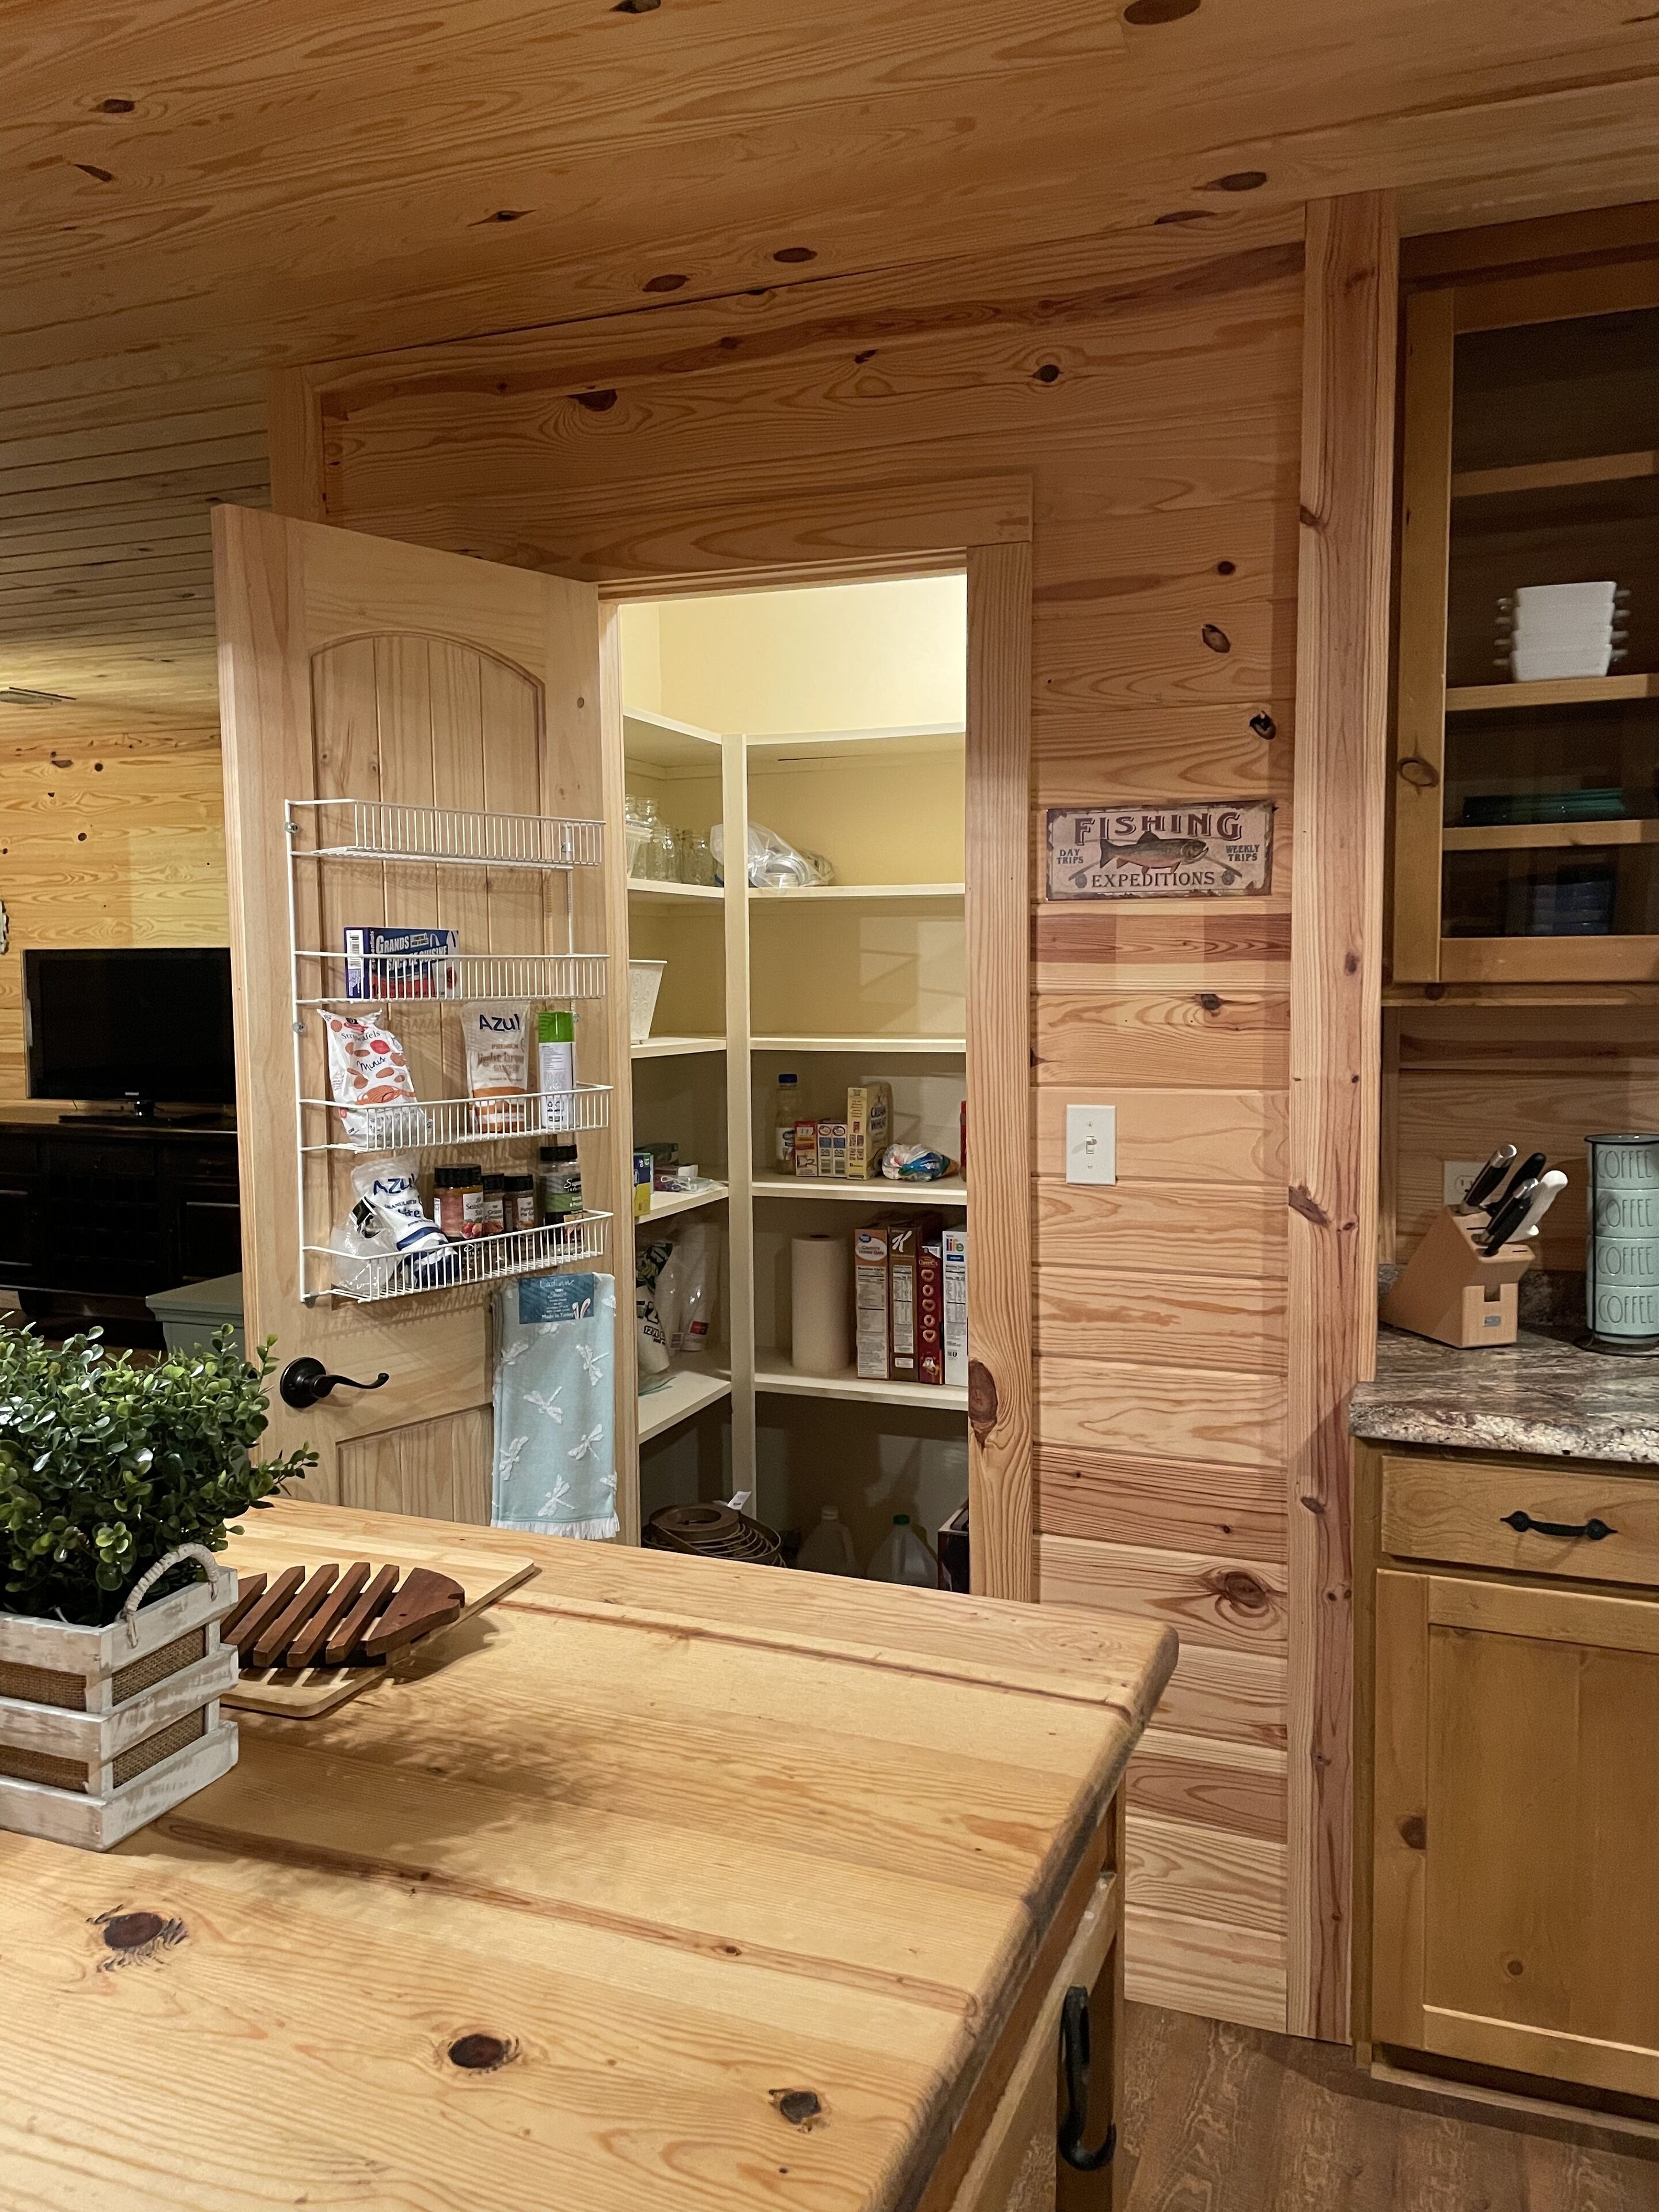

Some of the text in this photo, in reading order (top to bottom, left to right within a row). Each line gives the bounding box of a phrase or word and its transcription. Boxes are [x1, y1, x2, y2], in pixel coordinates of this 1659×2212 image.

[1074, 812, 1242, 845] FISHING
[1225, 844, 1260, 854] WEEKLY
[1228, 853, 1258, 862] TRIPS
[1056, 856, 1084, 864] TRIPS
[1092, 871, 1215, 888] EXPEDITIONS
[376, 935, 410, 955] GRANDS
[1597, 1150, 1652, 1178] COFFEE
[1598, 1199, 1654, 1227] COFFEE
[946, 1238, 964, 1252] life
[1597, 1246, 1654, 1275] COFFEE
[1599, 1295, 1654, 1324] COFFEE
